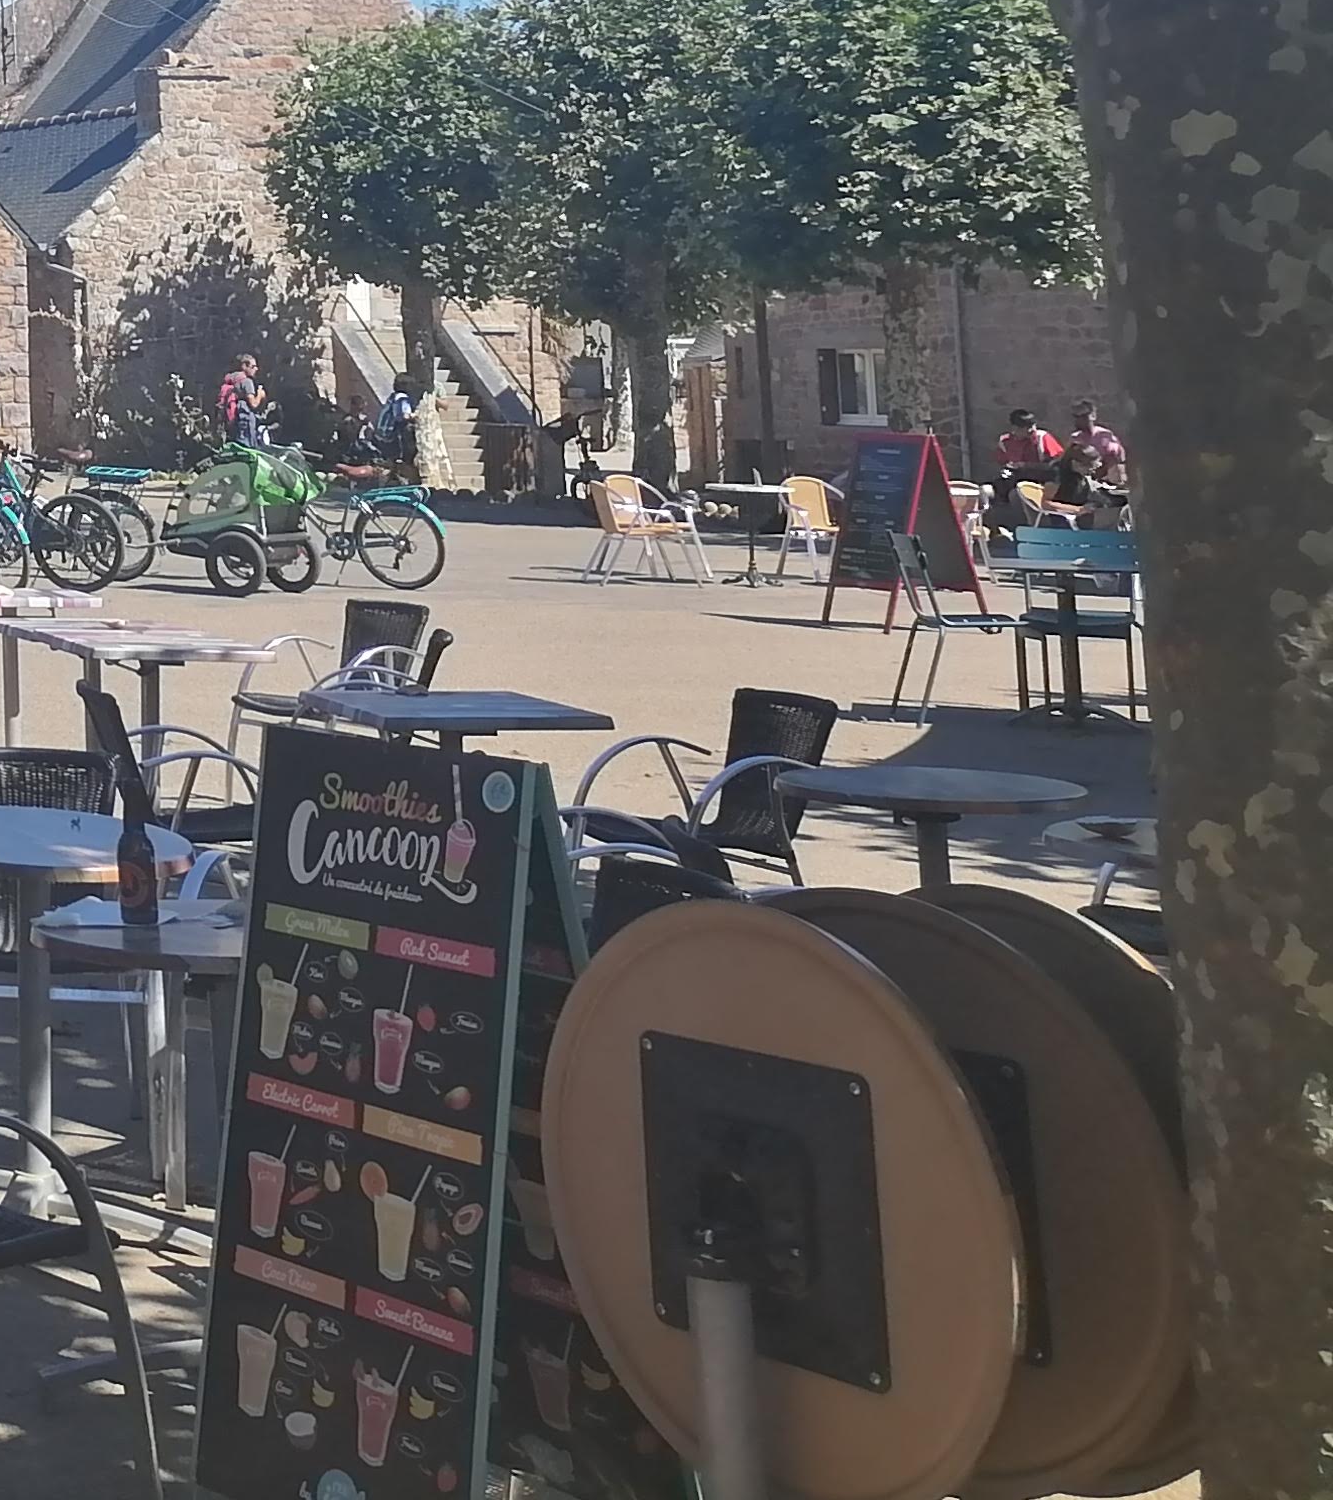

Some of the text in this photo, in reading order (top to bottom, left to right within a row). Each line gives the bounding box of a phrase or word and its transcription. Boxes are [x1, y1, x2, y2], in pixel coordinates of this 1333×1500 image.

[320, 773, 442, 823] Smoothies
[288, 800, 477, 904] Cancoon
[400, 937, 470, 967] Red Sunset
[262, 1083, 339, 1118] Electric Carrot
[375, 1300, 454, 1342] Sweet Banana
